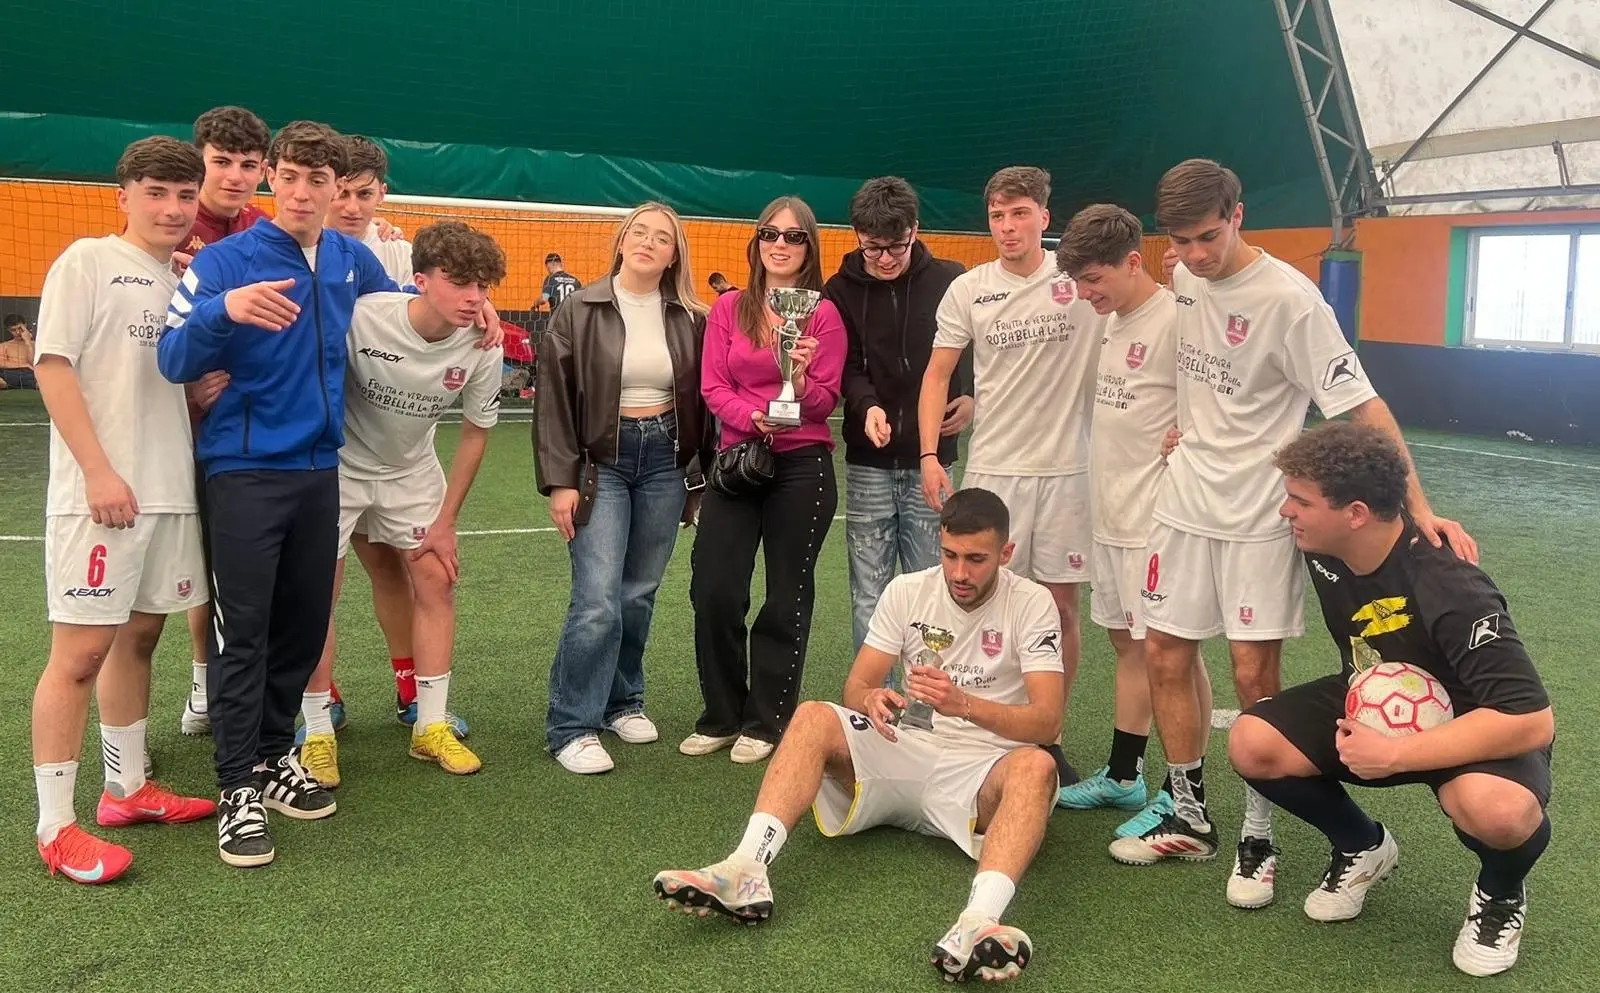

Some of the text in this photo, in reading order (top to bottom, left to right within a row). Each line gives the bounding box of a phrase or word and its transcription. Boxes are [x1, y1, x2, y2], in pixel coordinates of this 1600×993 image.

[985, 326, 1045, 346] ROBABELLA
[368, 378, 397, 395] FRUTTA
[406, 391, 444, 404] VERDURA
[87, 543, 107, 588] 6
[1147, 553, 1159, 593] 8
